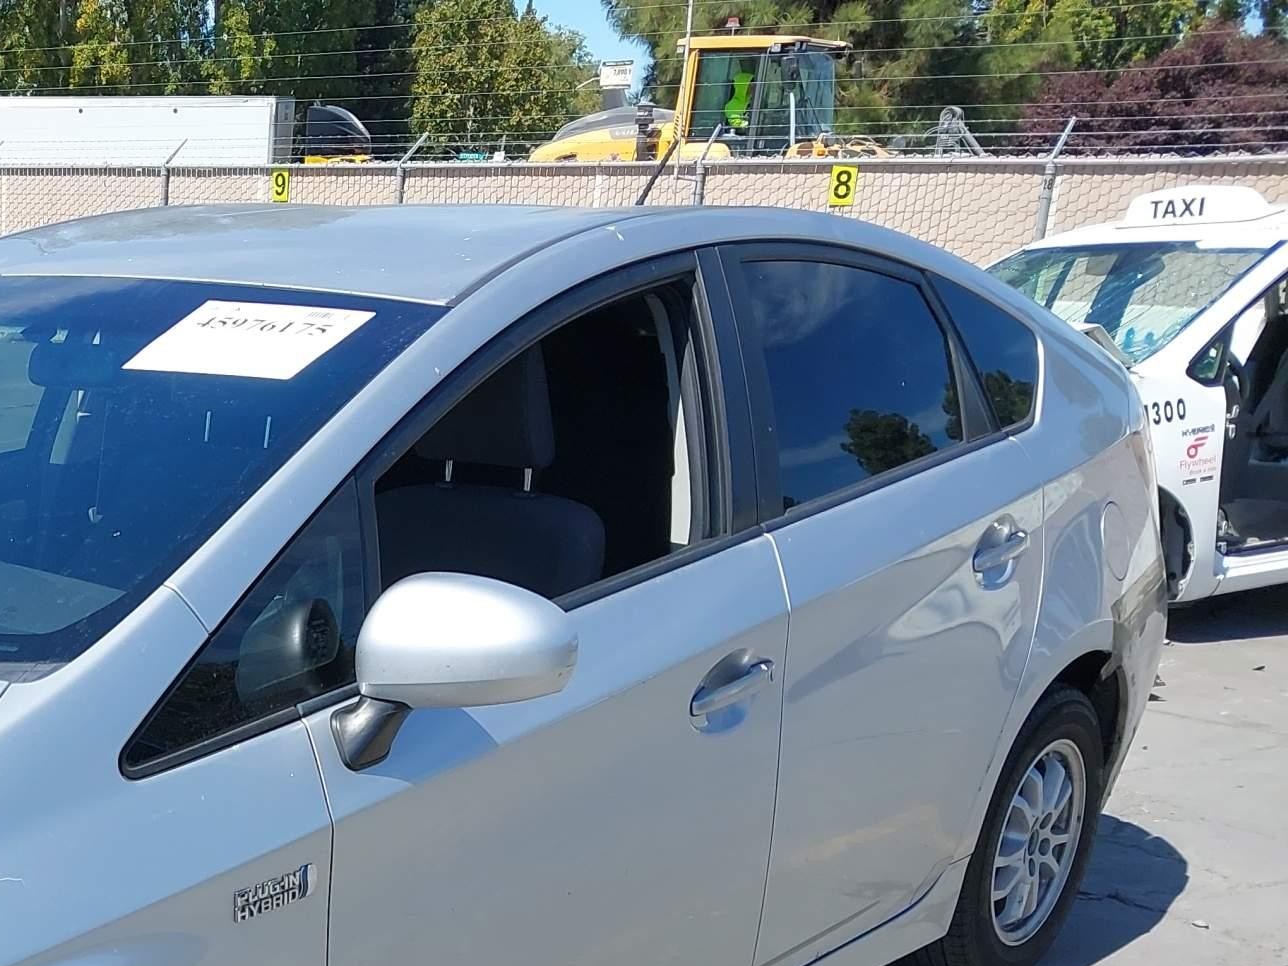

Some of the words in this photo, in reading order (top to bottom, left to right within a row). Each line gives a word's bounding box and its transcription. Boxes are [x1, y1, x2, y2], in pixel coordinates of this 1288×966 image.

[275, 172, 286, 196] 9
[833, 170, 852, 199] 8
[1150, 197, 1206, 219] TAXI
[196, 316, 334, 336] 45976175
[234, 872, 300, 906] PLUG-IN
[234, 889, 299, 923] HYBRID
